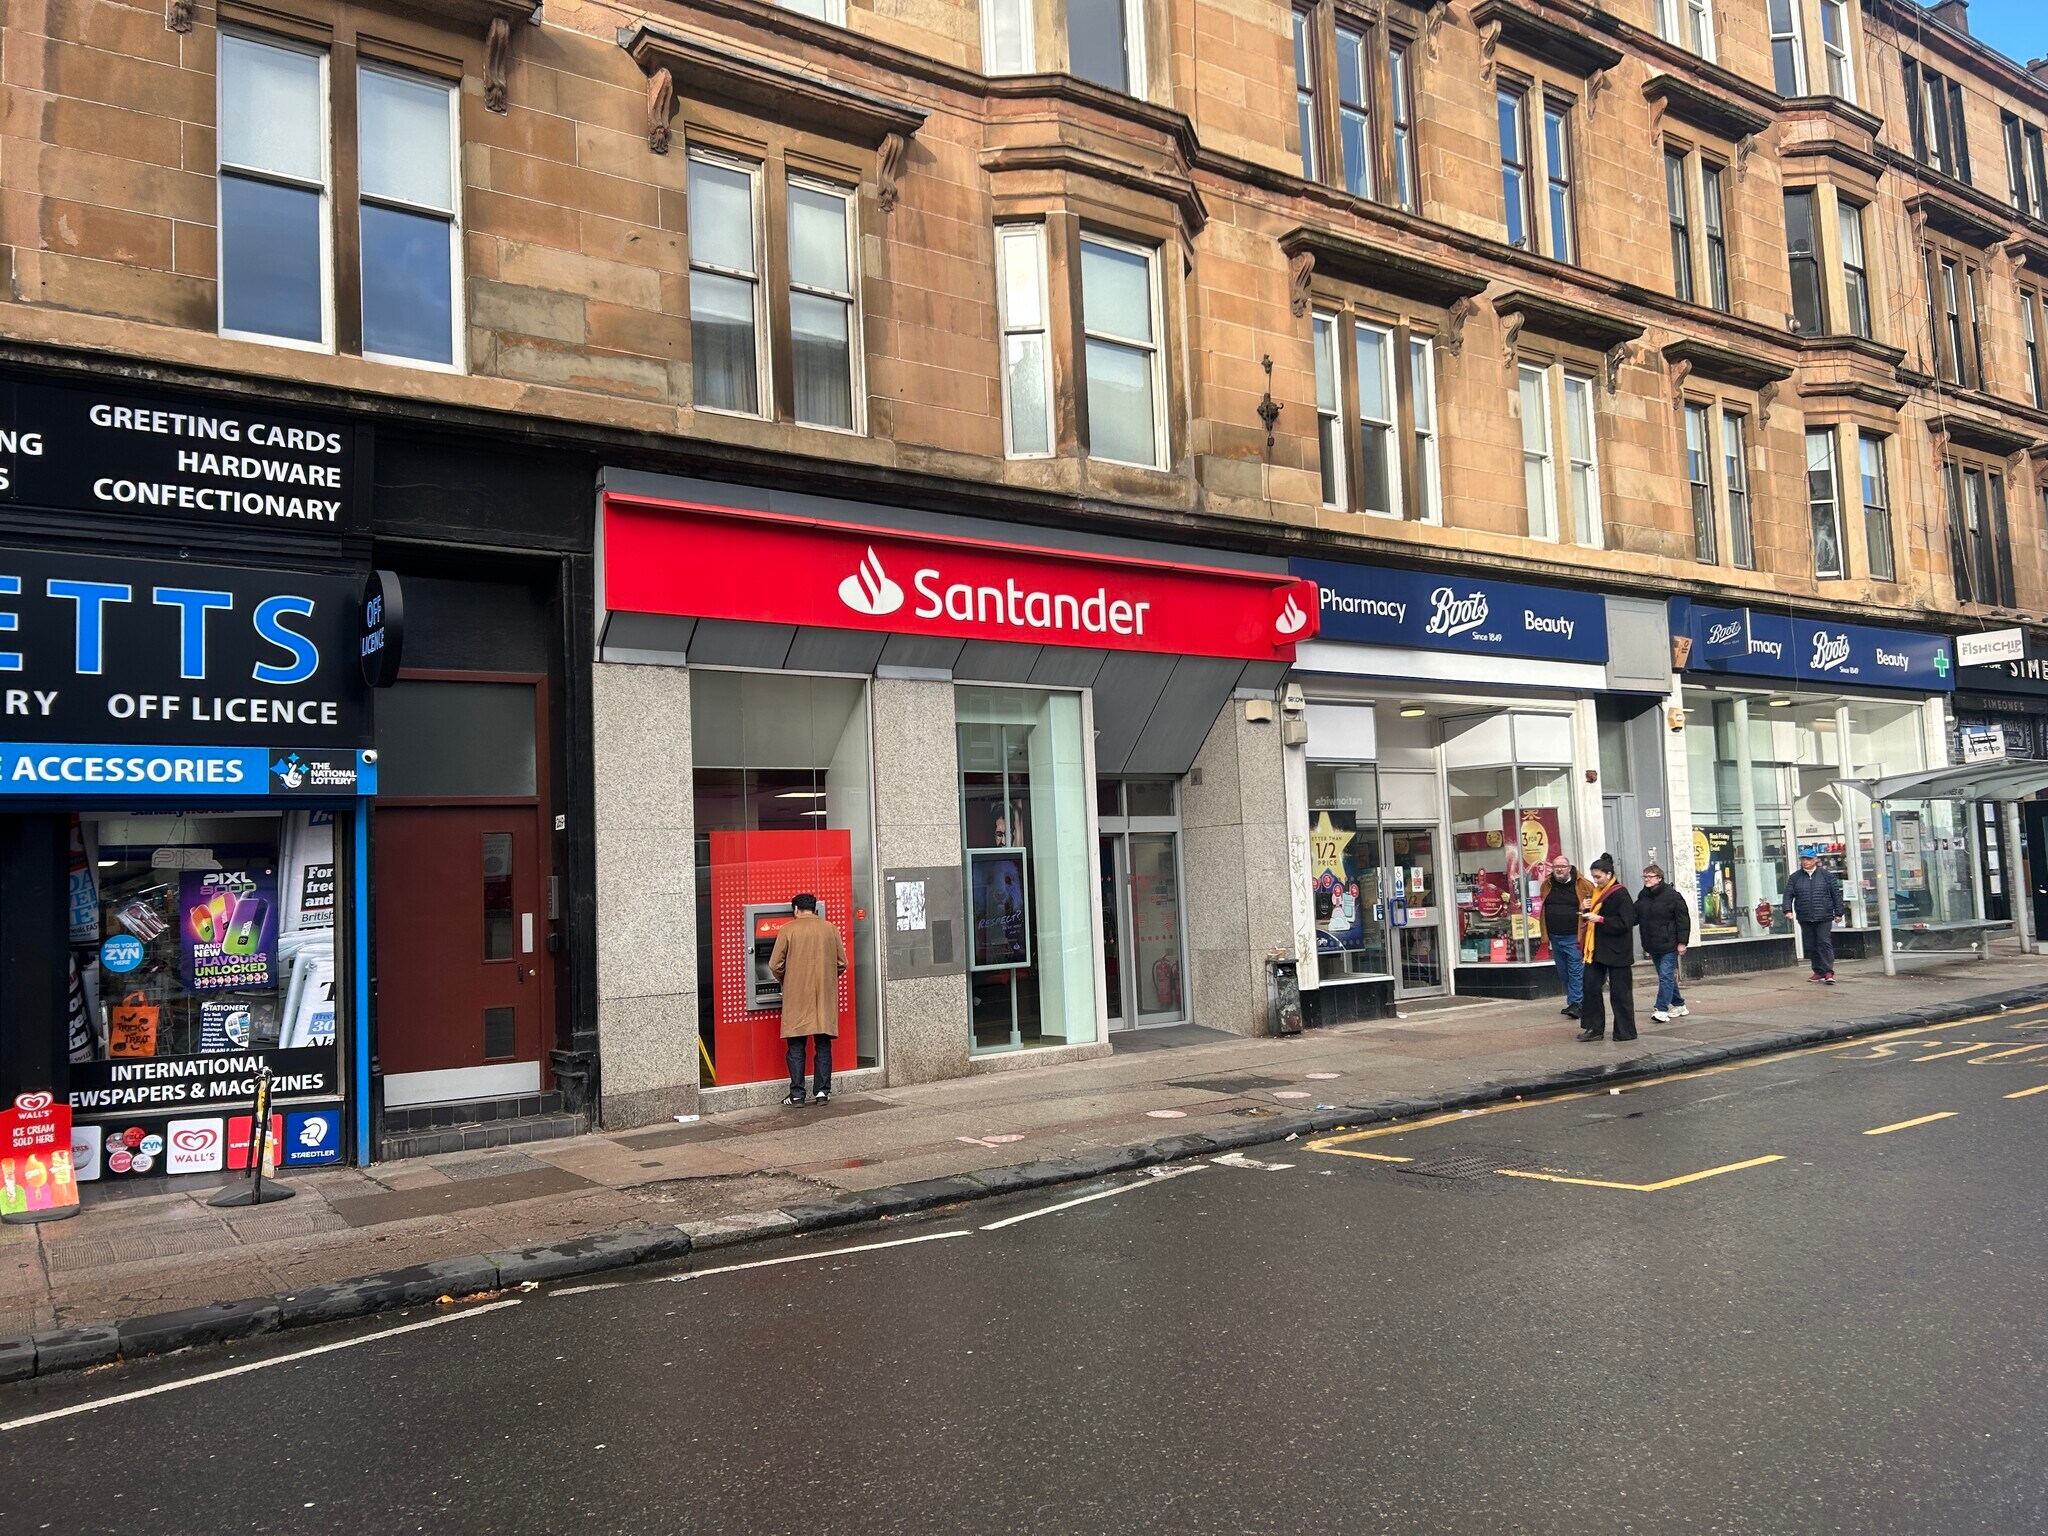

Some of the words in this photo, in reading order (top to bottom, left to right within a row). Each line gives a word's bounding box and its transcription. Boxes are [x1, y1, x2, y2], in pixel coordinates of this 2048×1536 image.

[89, 404, 240, 442] GREETING
[247, 423, 342, 454] CARDS
[178, 450, 341, 488] HARDWARE
[93, 478, 341, 522] CONFECTIONARY
[914, 568, 1150, 635] Santander
[1319, 587, 1407, 624] Pharmacy
[366, 595, 382, 628] OFF
[1425, 587, 1489, 637] Boots
[1525, 609, 1575, 640] Beauty
[1472, 631, 1488, 641] Since
[1488, 632, 1503, 642] 1849
[1706, 621, 1742, 645] Boots
[361, 626, 385, 657] LICENCE
[1962, 643, 1988, 656] FISH
[1993, 639, 2021, 652] CHIP
[1809, 630, 1850, 671] Boots
[1876, 648, 1909, 672] Beauty
[5, 689, 59, 716] RY
[107, 693, 181, 719] OFF
[192, 696, 338, 725] LICENCE
[11, 756, 244, 783] ACCESSORIES
[310, 762, 330, 770] THE
[310, 770, 357, 778] NATIONAL
[310, 777, 352, 785] LOTTERY
[1380, 802, 1391, 810] 277
[1646, 809, 1659, 817] 279
[1522, 832, 1529, 847] 3
[1537, 831, 1544, 846] 2
[1316, 842, 1337, 859] 1/2
[203, 871, 253, 886] PIXL
[200, 882, 257, 895] 8000
[105, 947, 140, 961] ZYN
[194, 949, 221, 958] NEW
[194, 953, 267, 968] FLAVOURS
[195, 962, 267, 977] UNLOCKED
[204, 1004, 249, 1012] STATIONERY
[117, 1022, 142, 1032] TRICK
[124, 1034, 151, 1044] TREAT
[111, 1055, 266, 1082] INTERNATIONAL
[69, 1083, 185, 1108] EWSPAPERS
[191, 1084, 205, 1099] &
[209, 1073, 324, 1097] MAGZINES
[18, 1110, 52, 1119] WALL'S
[13, 1127, 25, 1137] ICE
[27, 1124, 55, 1135] CREAM
[13, 1136, 33, 1147] SOLD
[36, 1134, 55, 1144] HERE
[141, 1141, 162, 1149] ZYN
[174, 1152, 216, 1163] WALL'S
[291, 1150, 335, 1159] STAEDTLER
